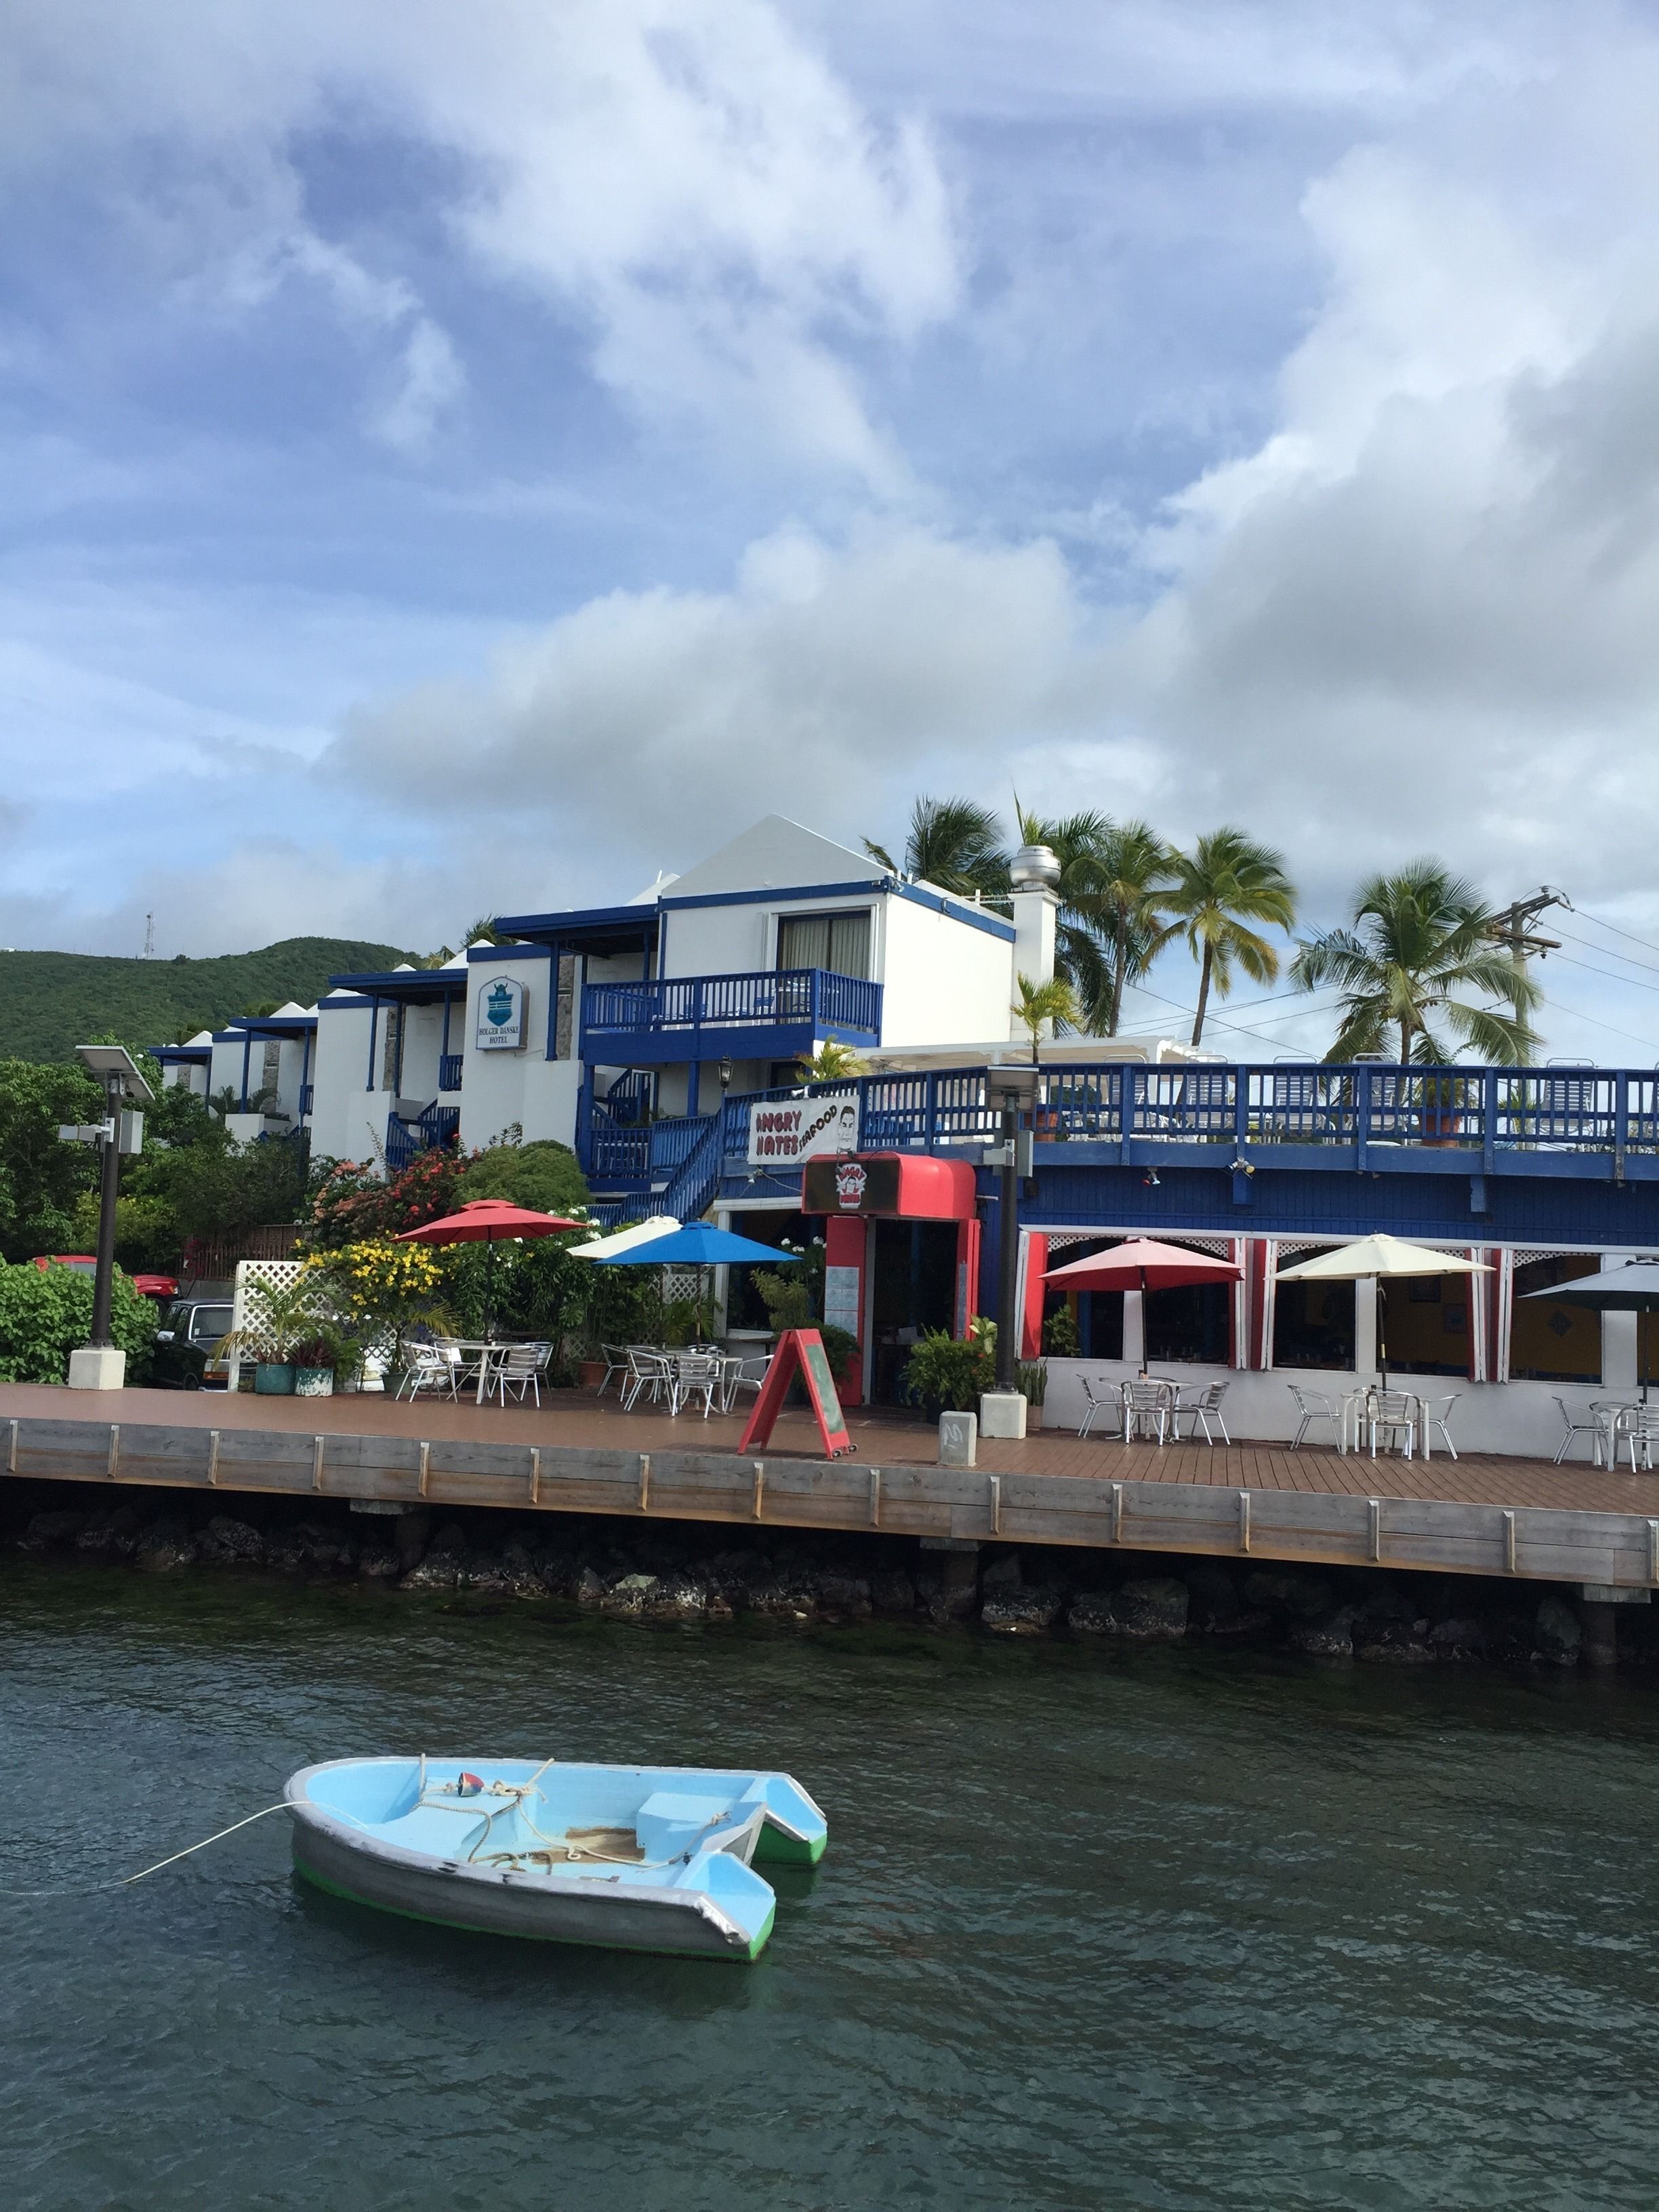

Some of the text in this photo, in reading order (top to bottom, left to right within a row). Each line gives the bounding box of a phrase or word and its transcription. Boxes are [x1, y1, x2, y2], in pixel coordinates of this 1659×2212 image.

[479, 1026, 519, 1036] HOLGER DANSKE
[756, 1110, 802, 1132] ANGRY
[799, 1105, 838, 1152] SEAFOOD
